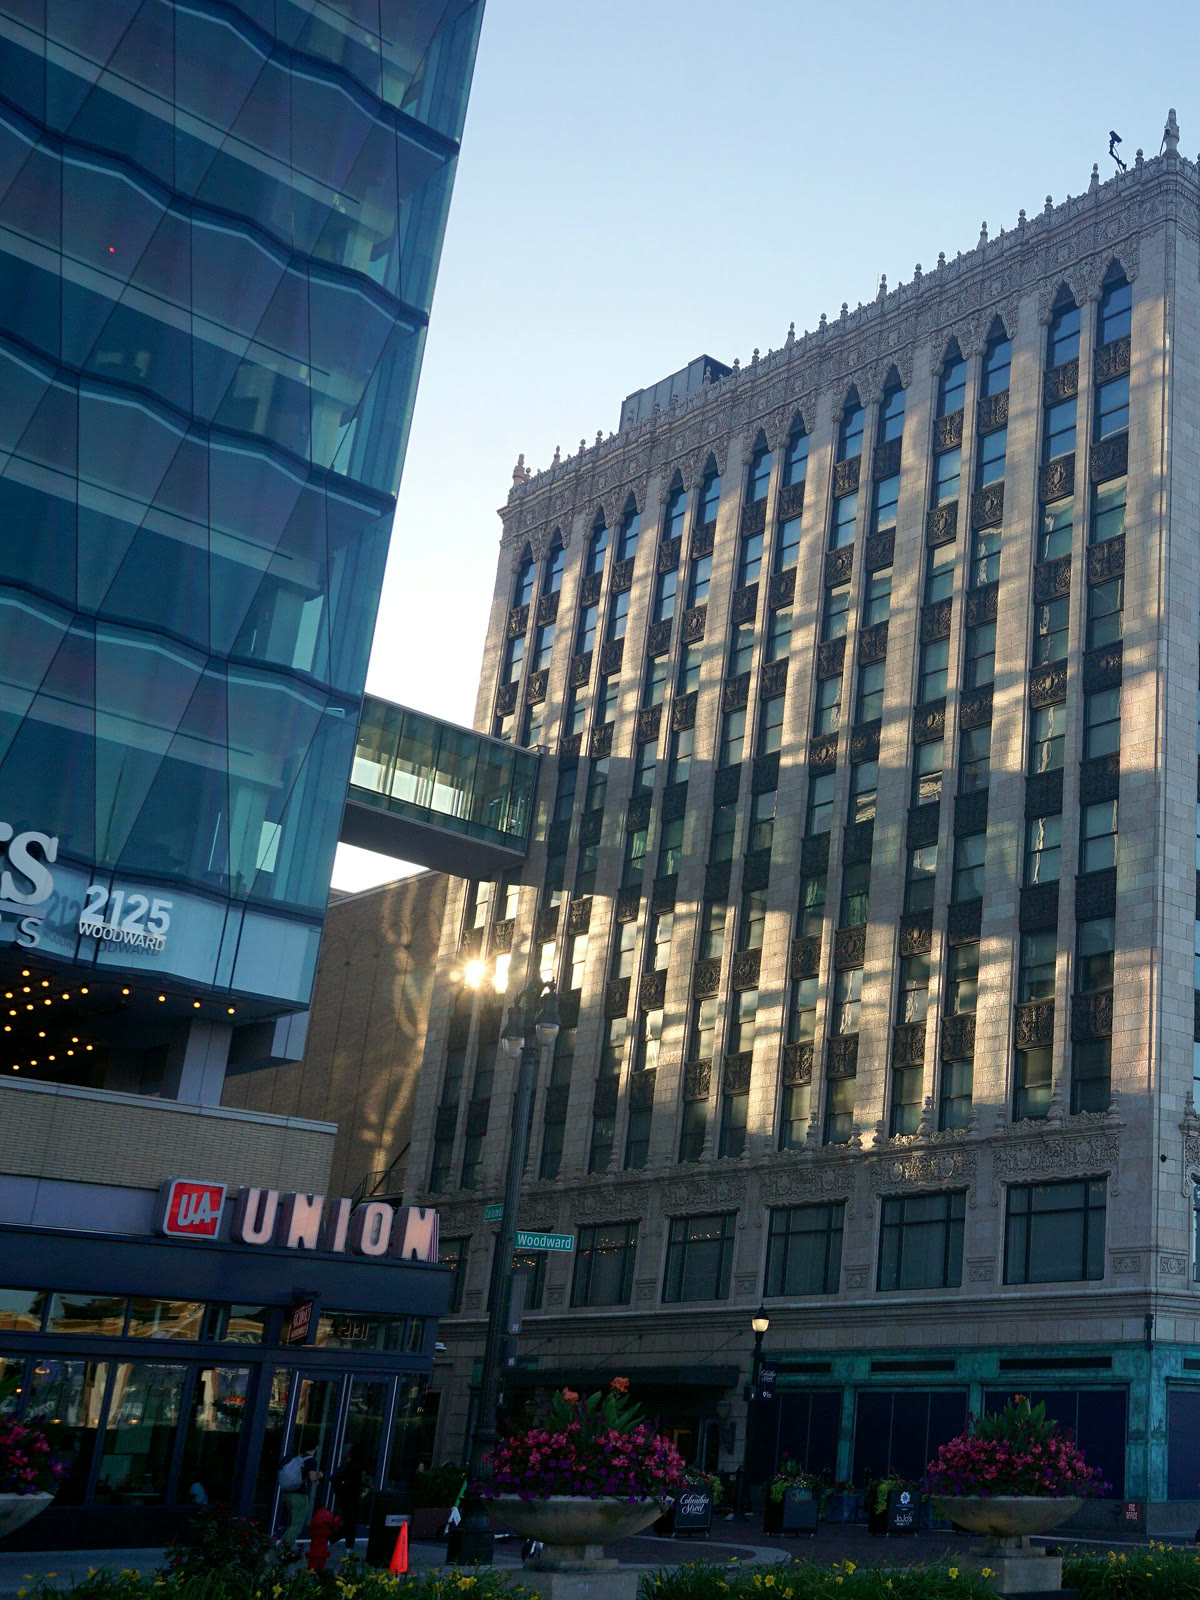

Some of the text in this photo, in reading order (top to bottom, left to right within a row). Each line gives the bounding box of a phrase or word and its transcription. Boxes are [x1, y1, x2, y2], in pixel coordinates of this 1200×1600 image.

[80, 885, 173, 936] 2125
[78, 921, 166, 951] WOODWARD
[177, 1186, 438, 1262] UA UNION
[517, 1234, 572, 1249] Woodward
[680, 1493, 709, 1505] Columbia
[681, 1503, 705, 1515] Street
